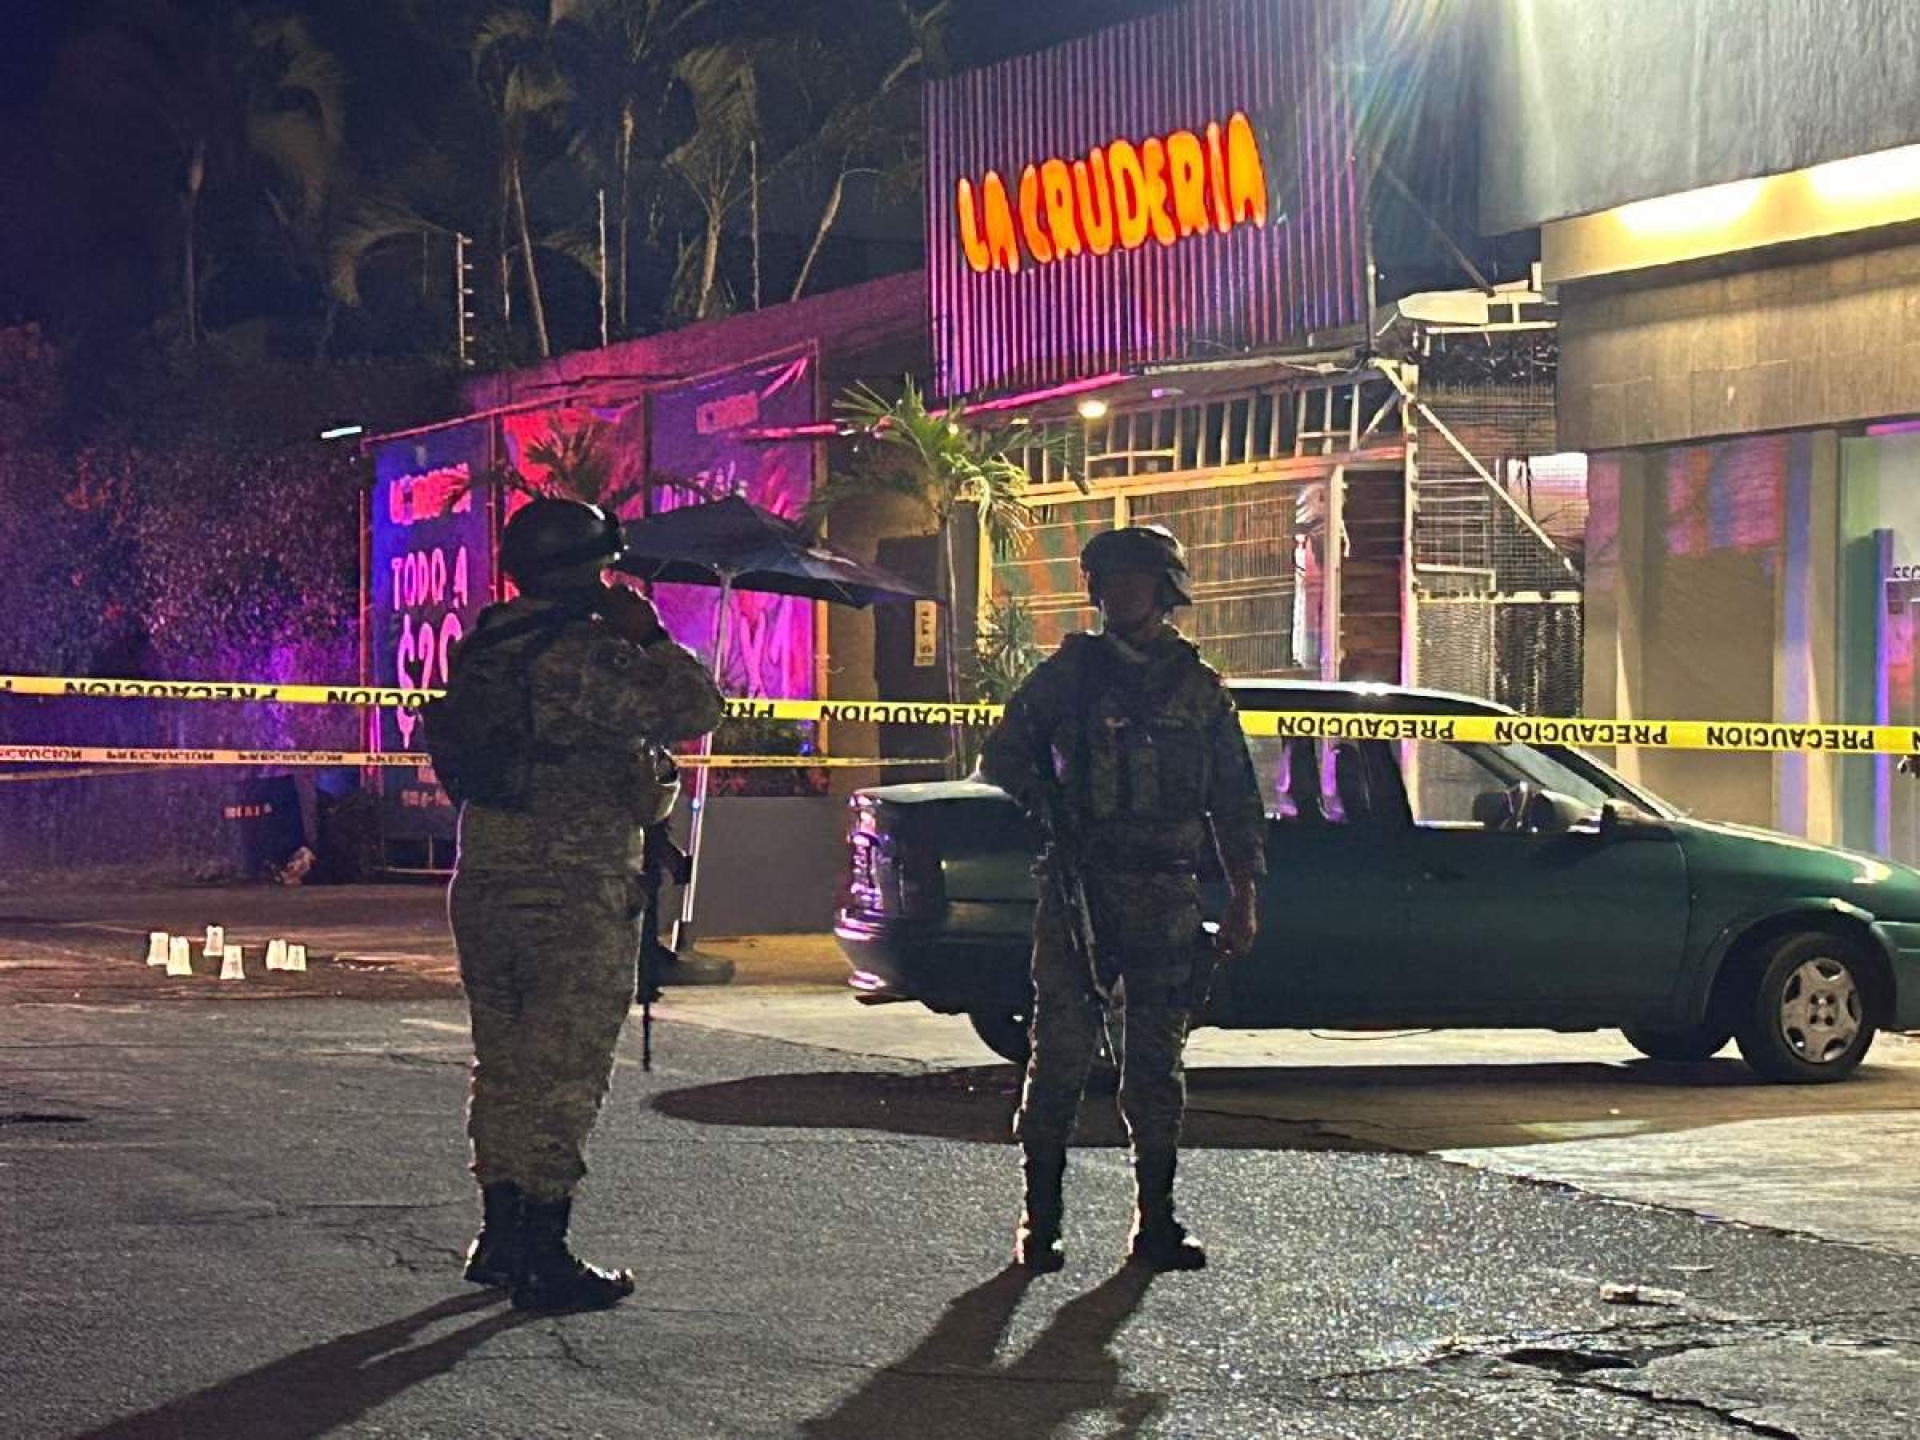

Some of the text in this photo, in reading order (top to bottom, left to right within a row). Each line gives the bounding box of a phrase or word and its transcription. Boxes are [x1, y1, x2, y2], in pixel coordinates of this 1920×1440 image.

[957, 111, 1267, 273] LA CRUDERIA
[391, 545, 468, 611] TODO A
[1277, 716, 1455, 739] PRECAUCION
[1495, 721, 1667, 744] PRECAUCION
[1706, 726, 1874, 749] PRECAUCION
